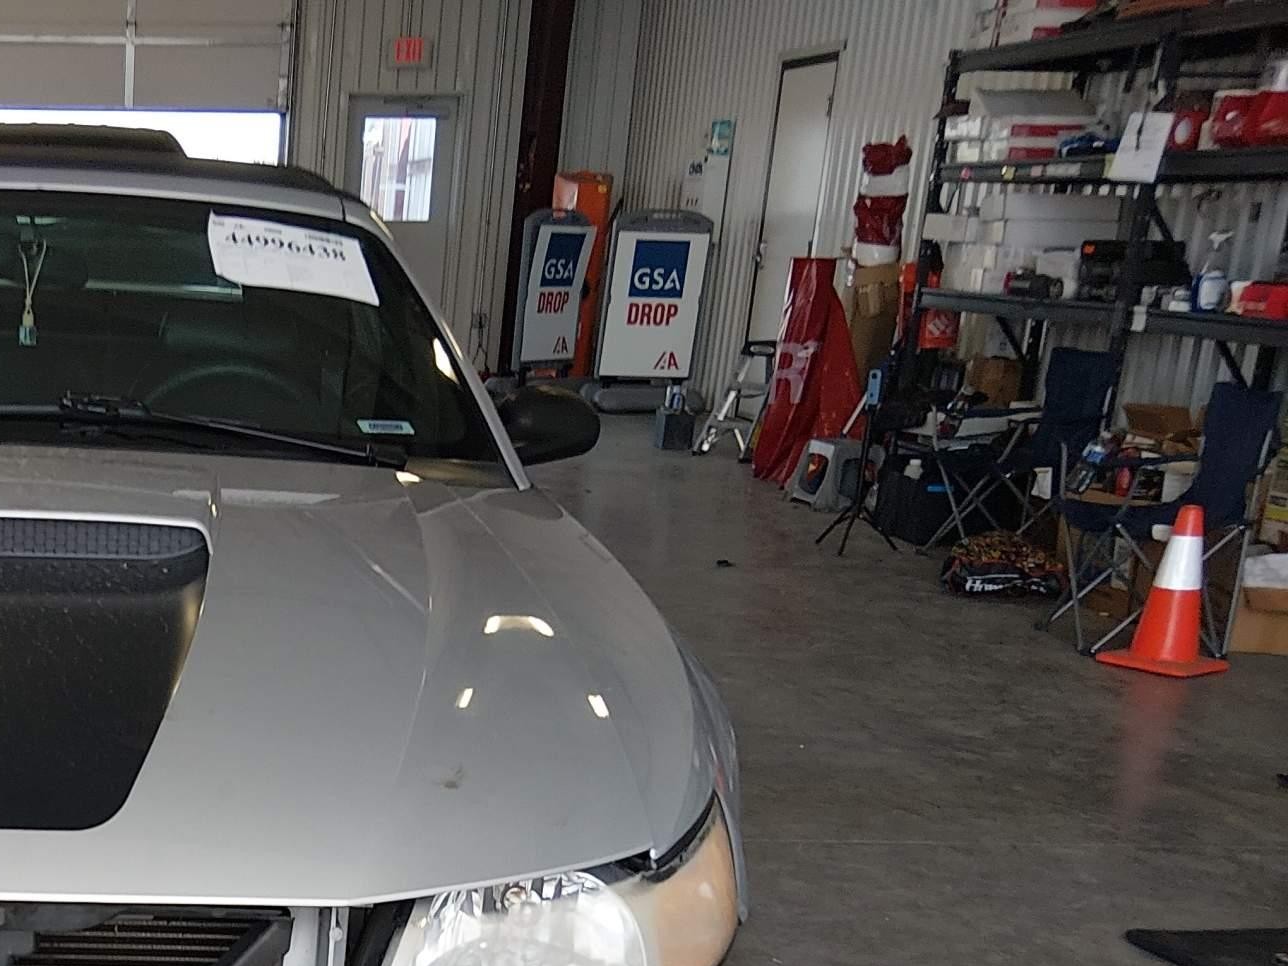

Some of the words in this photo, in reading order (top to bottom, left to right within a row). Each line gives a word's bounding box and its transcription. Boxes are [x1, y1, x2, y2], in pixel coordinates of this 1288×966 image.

[544, 258, 574, 280] GSA
[633, 266, 681, 292] GSA
[537, 291, 569, 315] DROP
[626, 303, 679, 327] DROP
